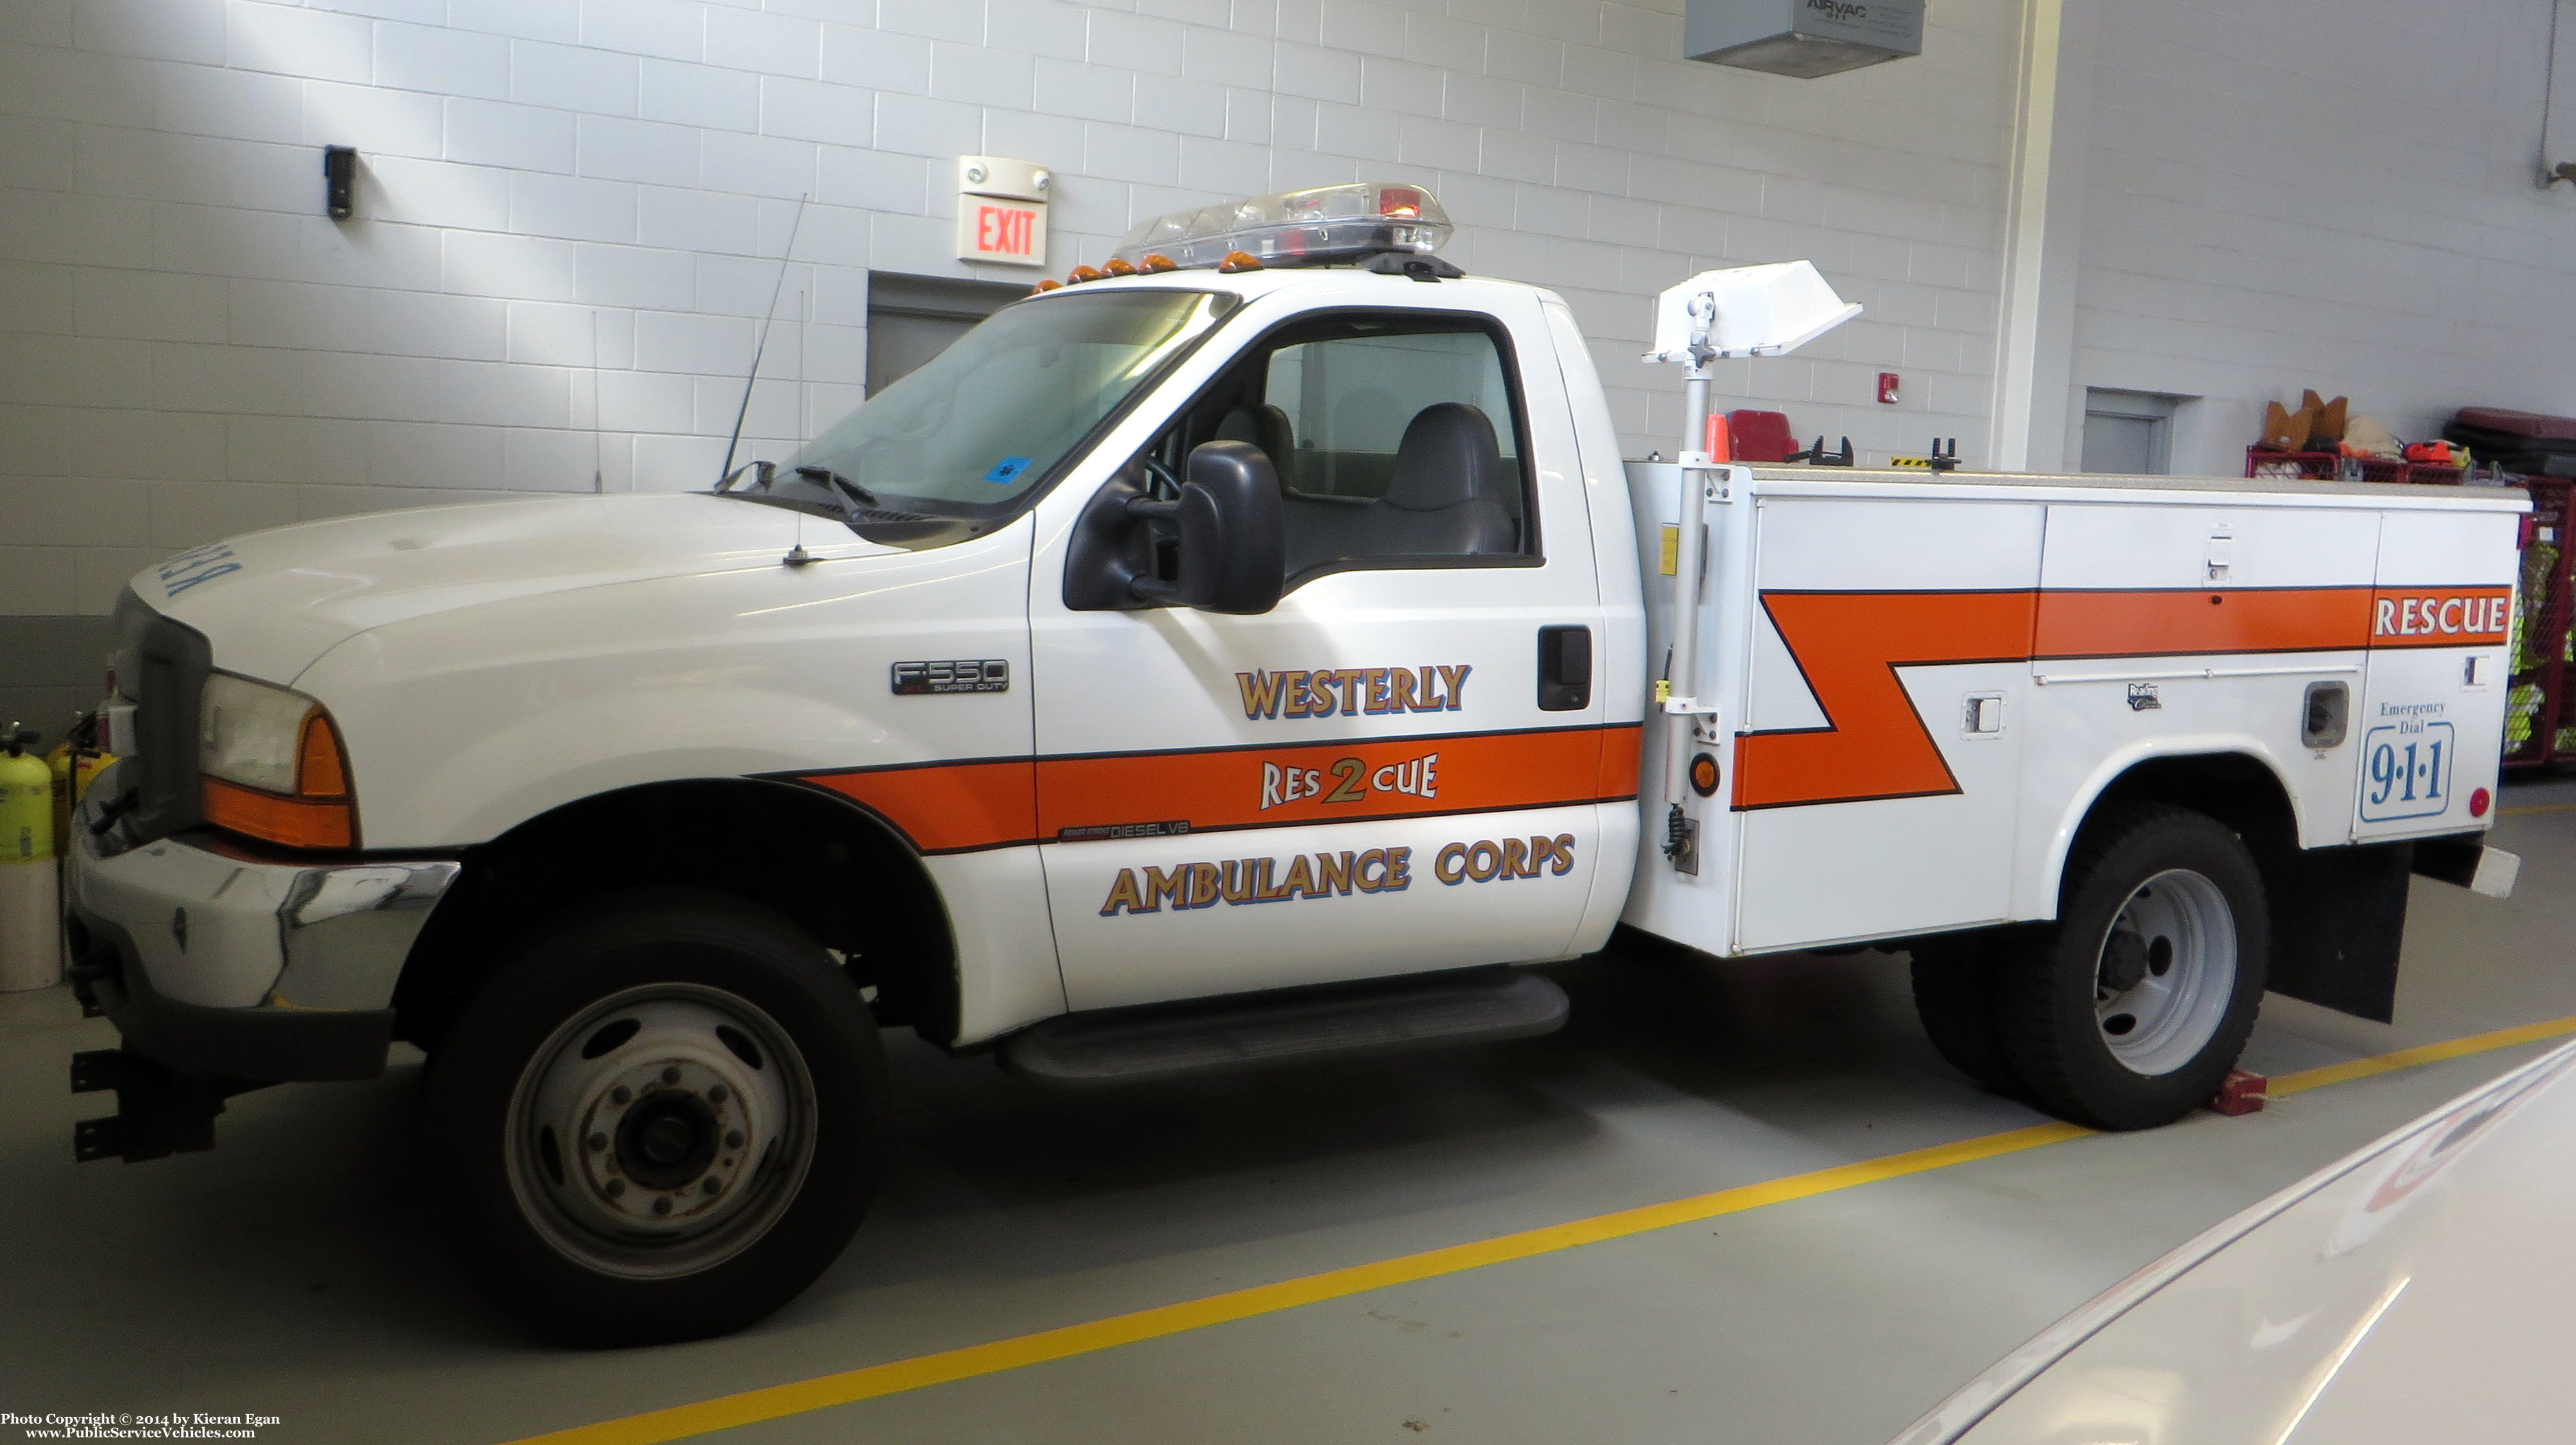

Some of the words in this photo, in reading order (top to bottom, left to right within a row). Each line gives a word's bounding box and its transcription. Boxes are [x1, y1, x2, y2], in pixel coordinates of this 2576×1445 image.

[1806, 0, 1866, 18] AIRVAC
[978, 205, 1036, 255] EXIT
[2375, 596, 2507, 637] RESCUE
[893, 661, 1008, 685] F-550
[934, 683, 974, 692] SUPER
[976, 682, 1009, 690] DUTY
[1234, 664, 1473, 720] WESTERLY
[2380, 701, 2446, 718] Emergency
[2399, 720, 2424, 734] Dial
[1110, 823, 1167, 838] DIESEL
[1168, 821, 1189, 834] V8
[1099, 846, 1413, 916] AMBULANCE
[1435, 833, 1575, 885] CORPS
